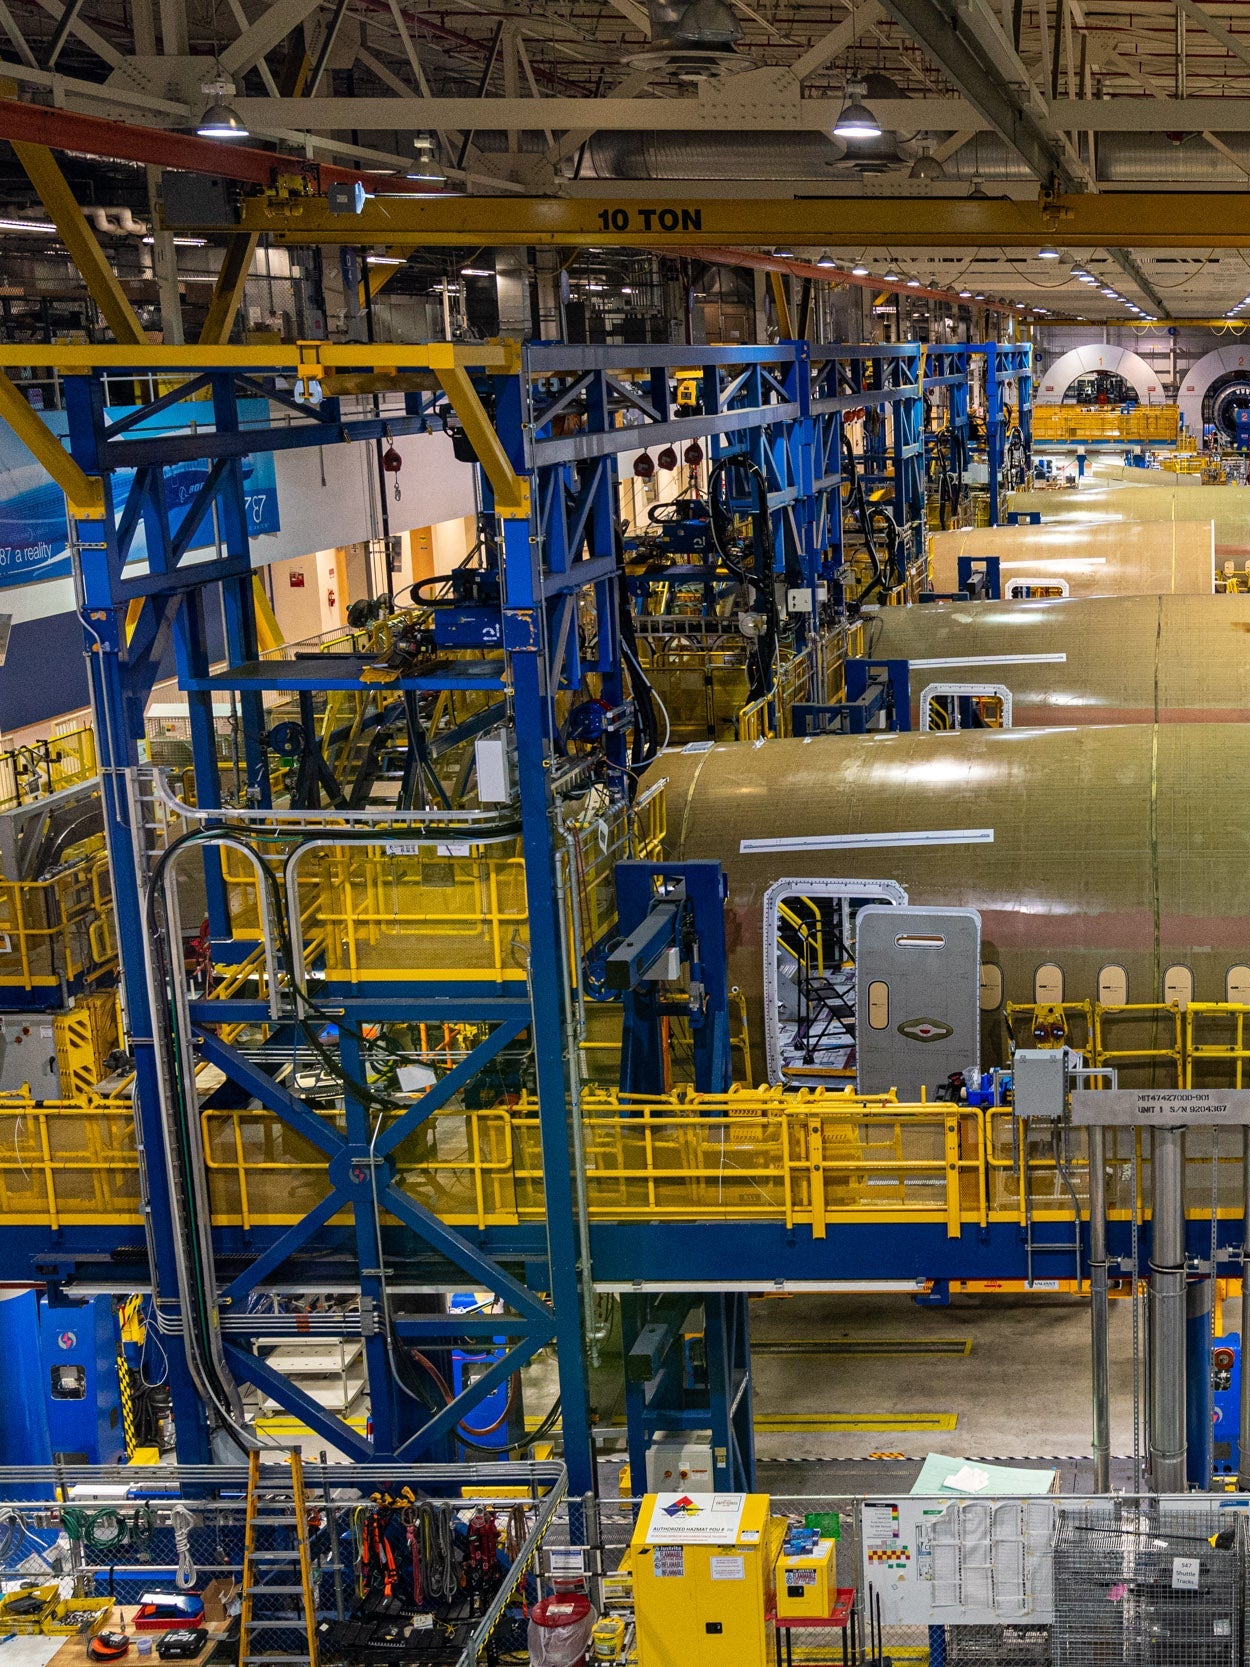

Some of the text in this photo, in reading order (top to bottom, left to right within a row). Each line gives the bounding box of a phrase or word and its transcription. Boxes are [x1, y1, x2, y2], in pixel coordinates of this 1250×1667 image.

[598, 208, 702, 231] 10 TON
[1238, 356, 1245, 366] 2
[1241, 412, 1248, 421] 2
[15, 549, 23, 563] a
[24, 541, 52, 561] reality
[1137, 1106, 1156, 1114] UNIT
